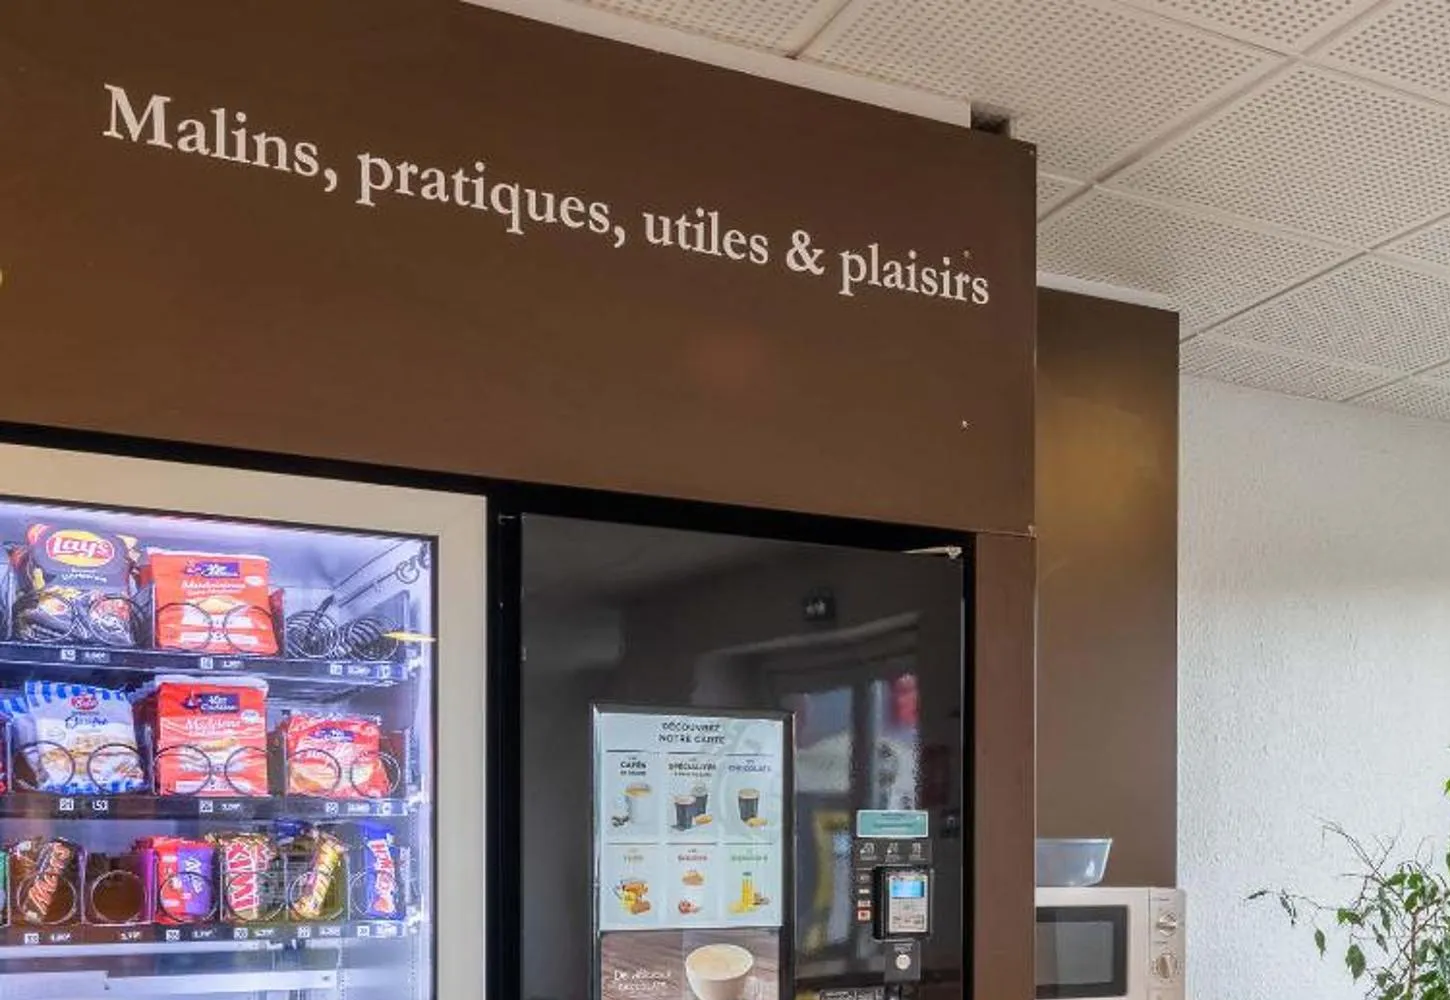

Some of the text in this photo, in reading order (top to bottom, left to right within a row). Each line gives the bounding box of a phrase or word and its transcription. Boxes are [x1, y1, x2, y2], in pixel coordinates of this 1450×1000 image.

[103, 83, 989, 305] Malins, pratiques, utiles & plaisirs
